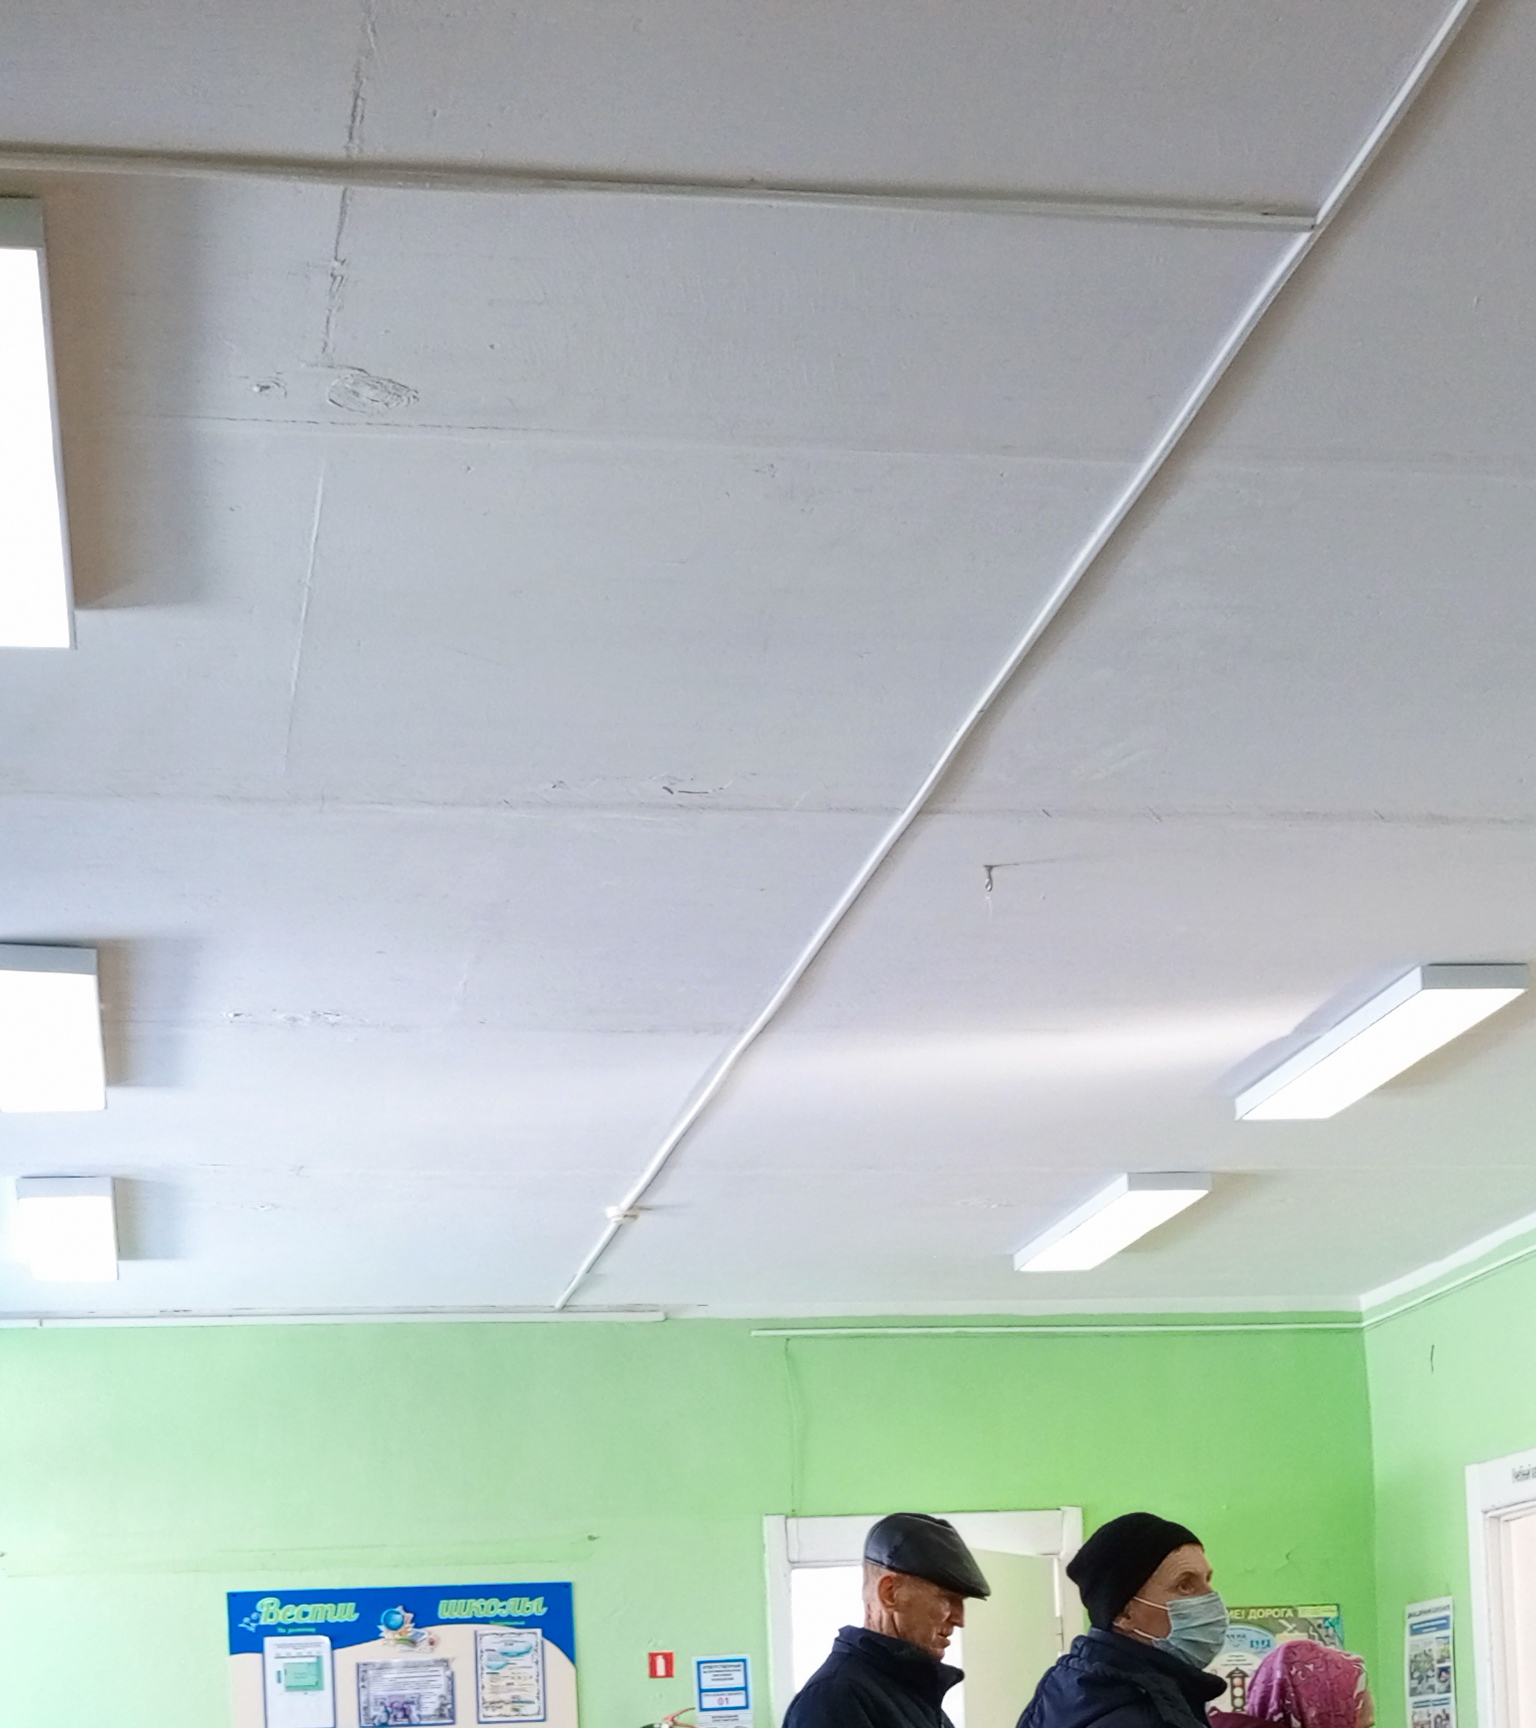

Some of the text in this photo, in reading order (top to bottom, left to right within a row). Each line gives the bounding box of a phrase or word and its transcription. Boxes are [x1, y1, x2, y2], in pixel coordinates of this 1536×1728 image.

[256, 1595, 549, 1626] Вести школы
[1247, 1608, 1294, 1619] ДОРОГА
